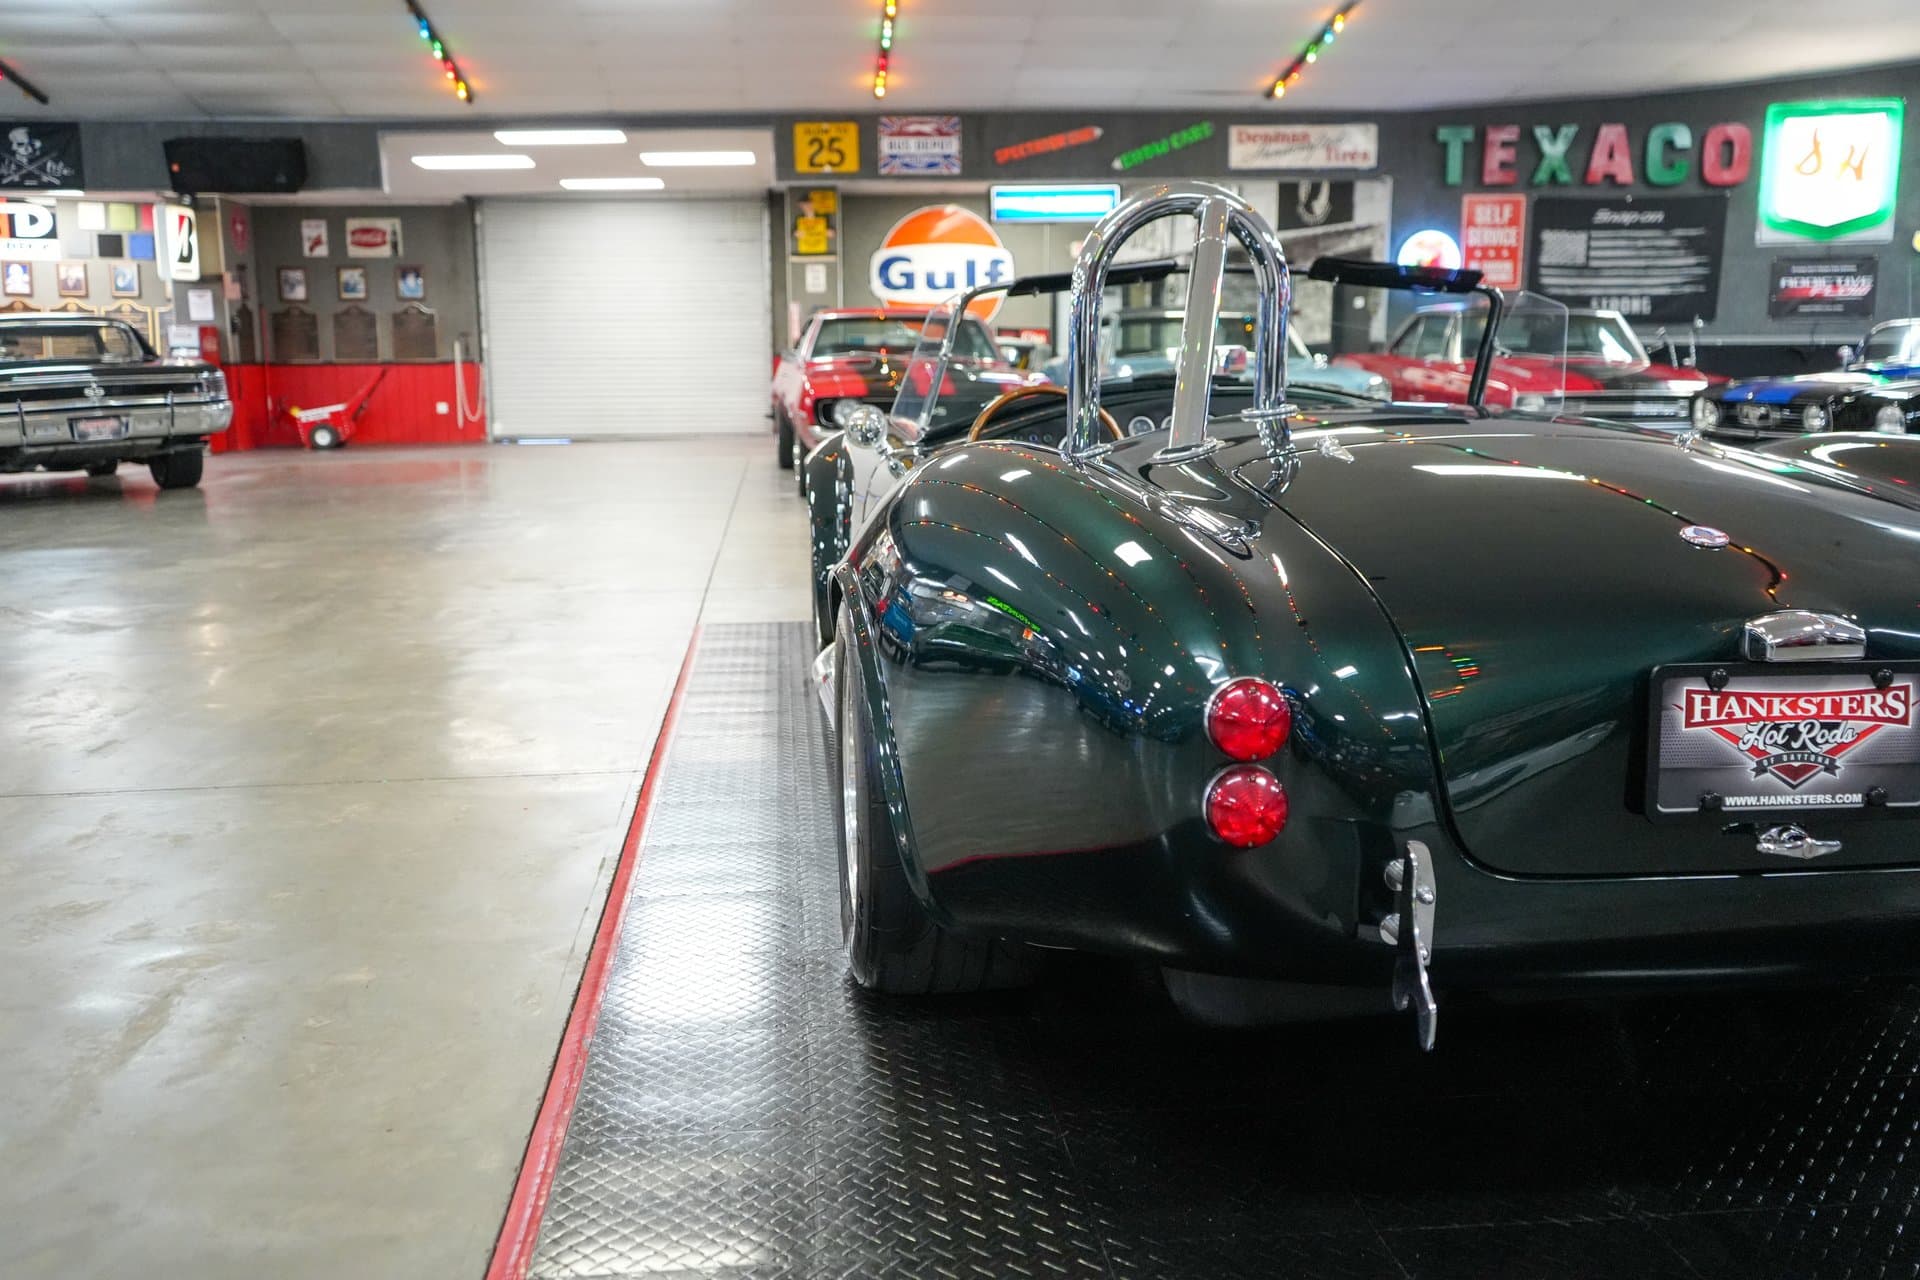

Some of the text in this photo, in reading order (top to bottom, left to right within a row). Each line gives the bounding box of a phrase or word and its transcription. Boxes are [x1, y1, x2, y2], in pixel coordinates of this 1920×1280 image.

[808, 137, 846, 168] 25
[1437, 122, 1753, 186] TEXACO
[1475, 203, 1514, 225] SELF
[1467, 226, 1519, 247] SERVICE
[878, 256, 1005, 290] Gulf
[1690, 690, 1907, 723] HANKSTERS
[1738, 718, 1859, 753] Hot Rods
[1783, 753, 1830, 765] DAYTONA
[1725, 793, 1863, 806] WWW.HANKSTERS.COM
